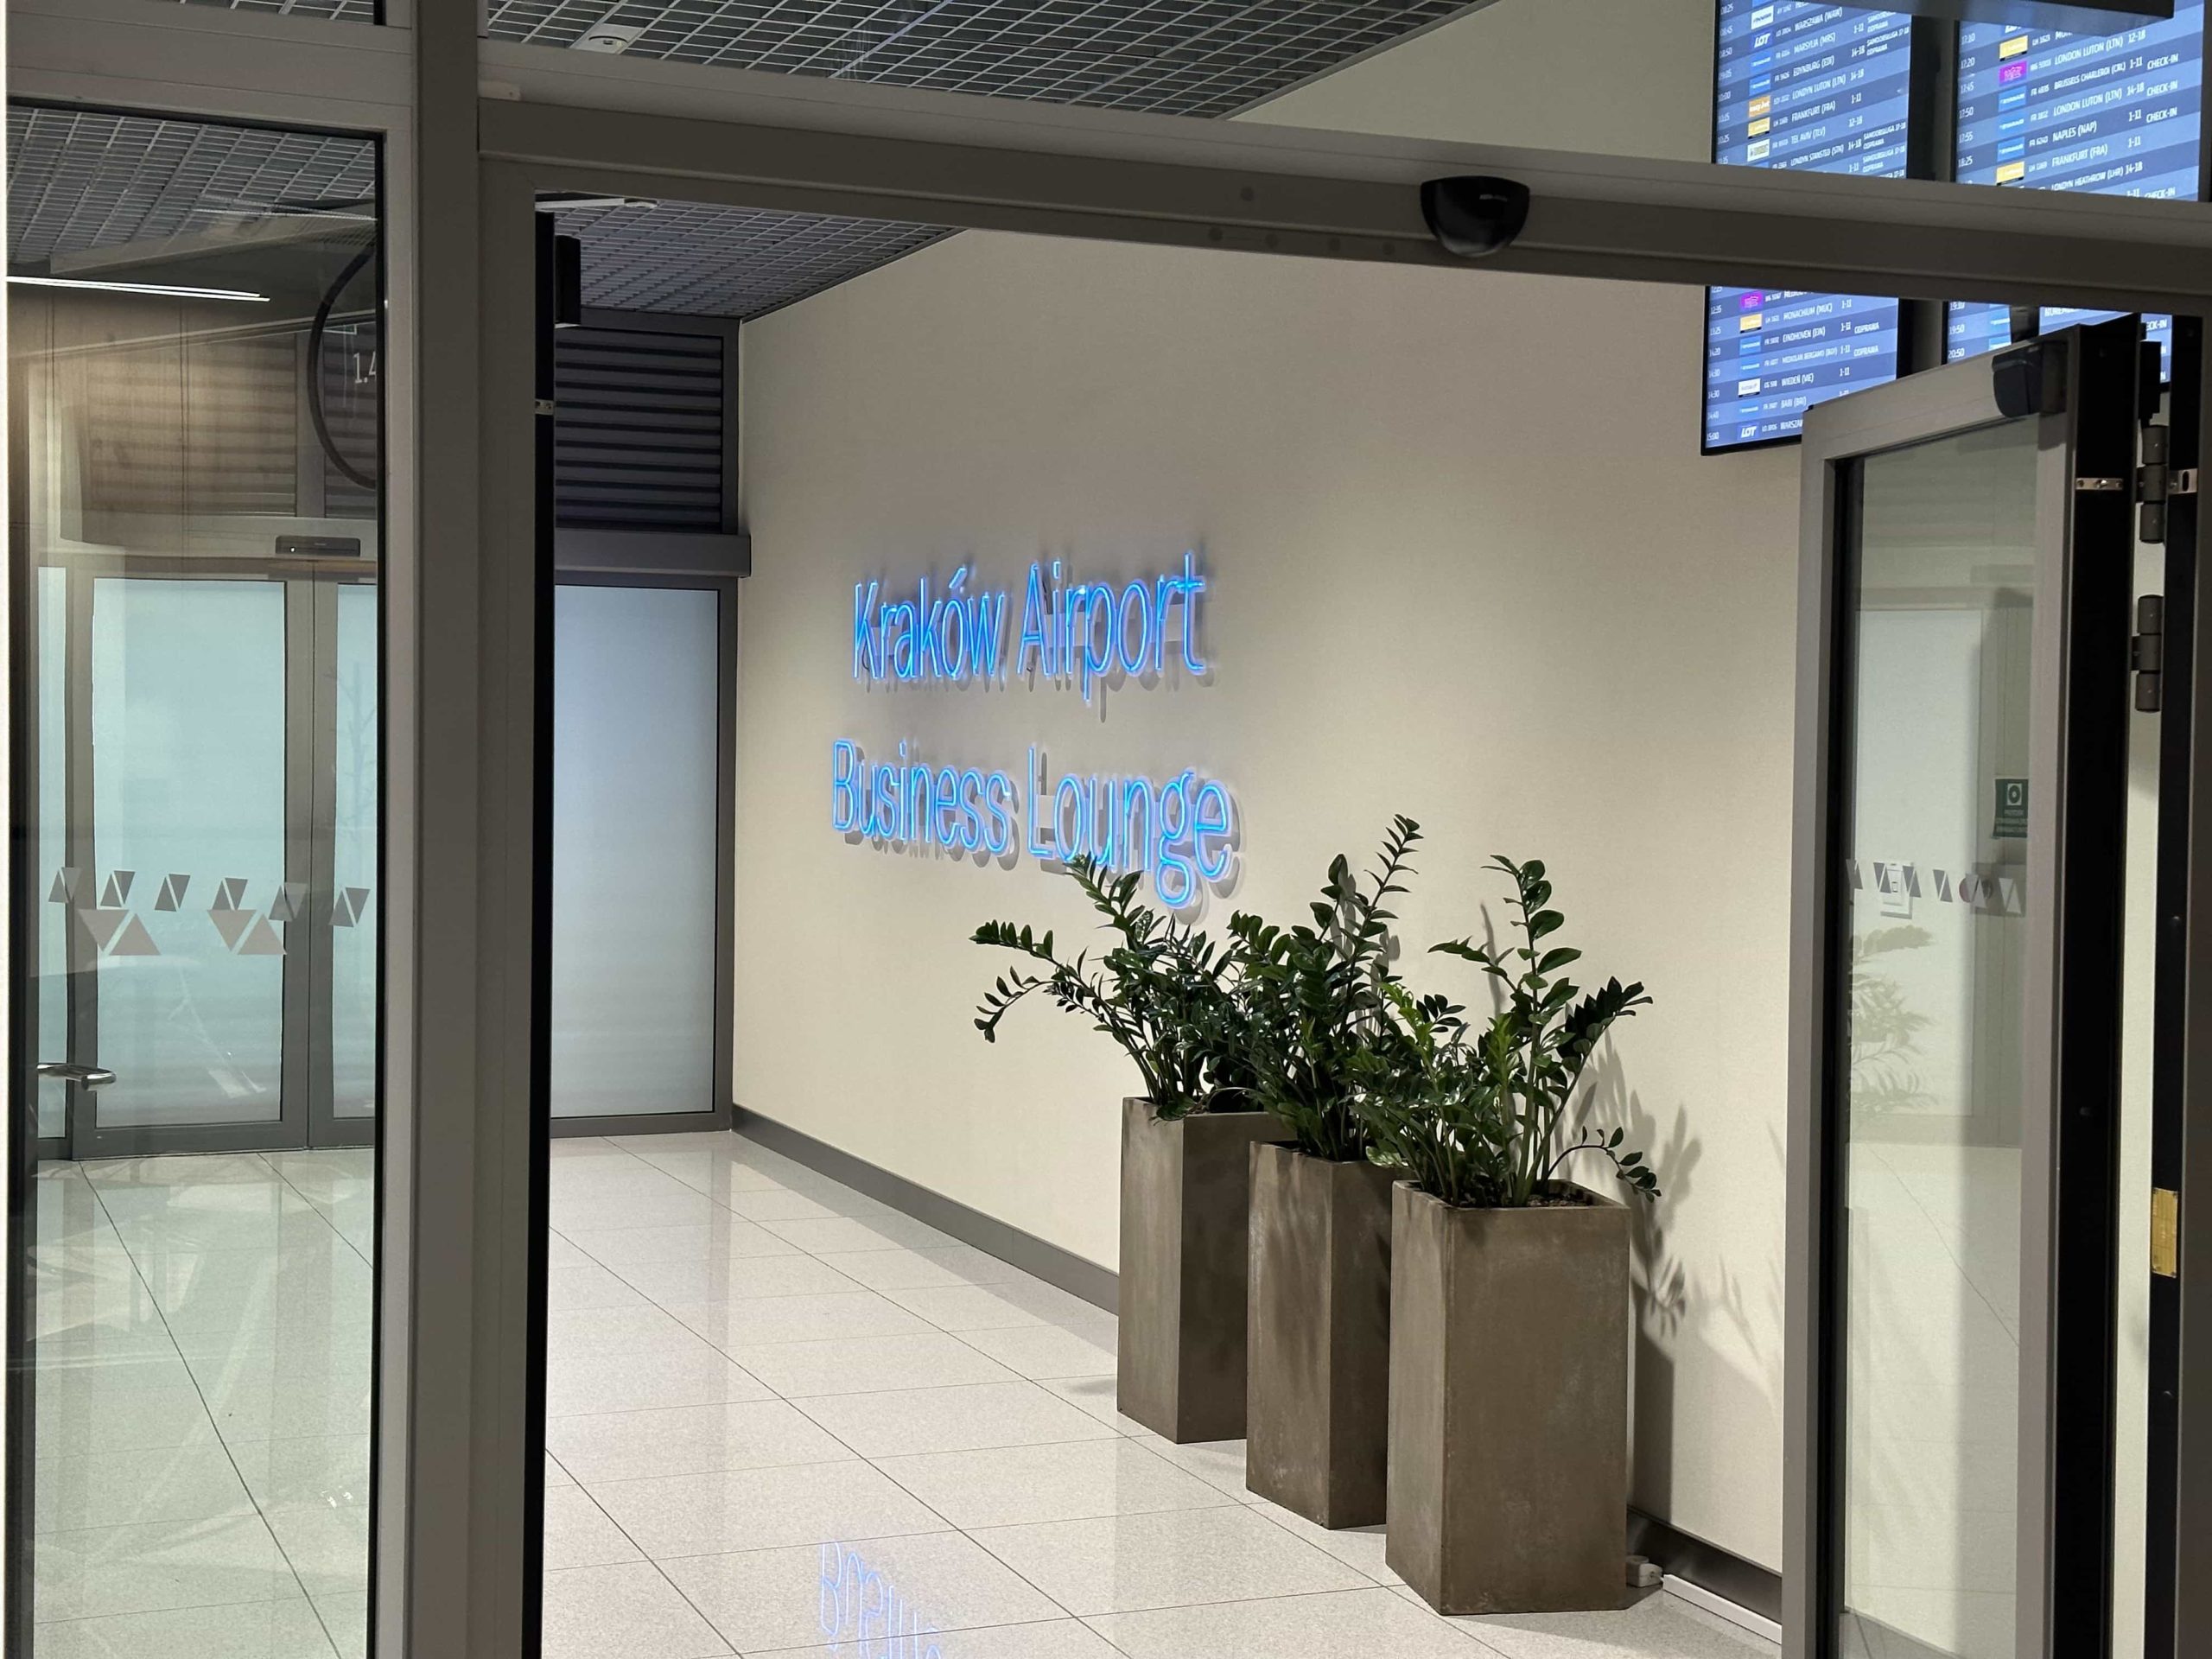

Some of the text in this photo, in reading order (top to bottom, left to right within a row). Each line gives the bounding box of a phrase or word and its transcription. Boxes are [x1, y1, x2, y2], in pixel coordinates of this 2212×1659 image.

[1755, 33, 1771, 48] LOT
[2055, 48, 2082, 65] LONDON
[2083, 41, 2104, 57] LUTON
[2106, 35, 2123, 52] (LTN)
[2054, 75, 2080, 90] BRUSSELS
[2147, 54, 2178, 70] CHECK-IN
[2053, 99, 2081, 117] LONDON
[2082, 94, 2103, 110] LUTON
[2105, 88, 2122, 105] (LTN)
[2146, 80, 2178, 97] CHECK-IN
[2052, 127, 2076, 143] NAPLES
[2078, 121, 2097, 137] (NAP)
[2146, 107, 2177, 123] CHECK-IN
[2052, 149, 2088, 167] FRANKFURT
[2090, 143, 2107, 160] (FRA)
[1949, 324, 1965, 335] 19:50
[1948, 347, 1965, 359] 20:50
[1741, 426, 1758, 438] LOT
[853, 551, 1206, 704] Kraków Airport
[833, 738, 1232, 908] Business Lounge
